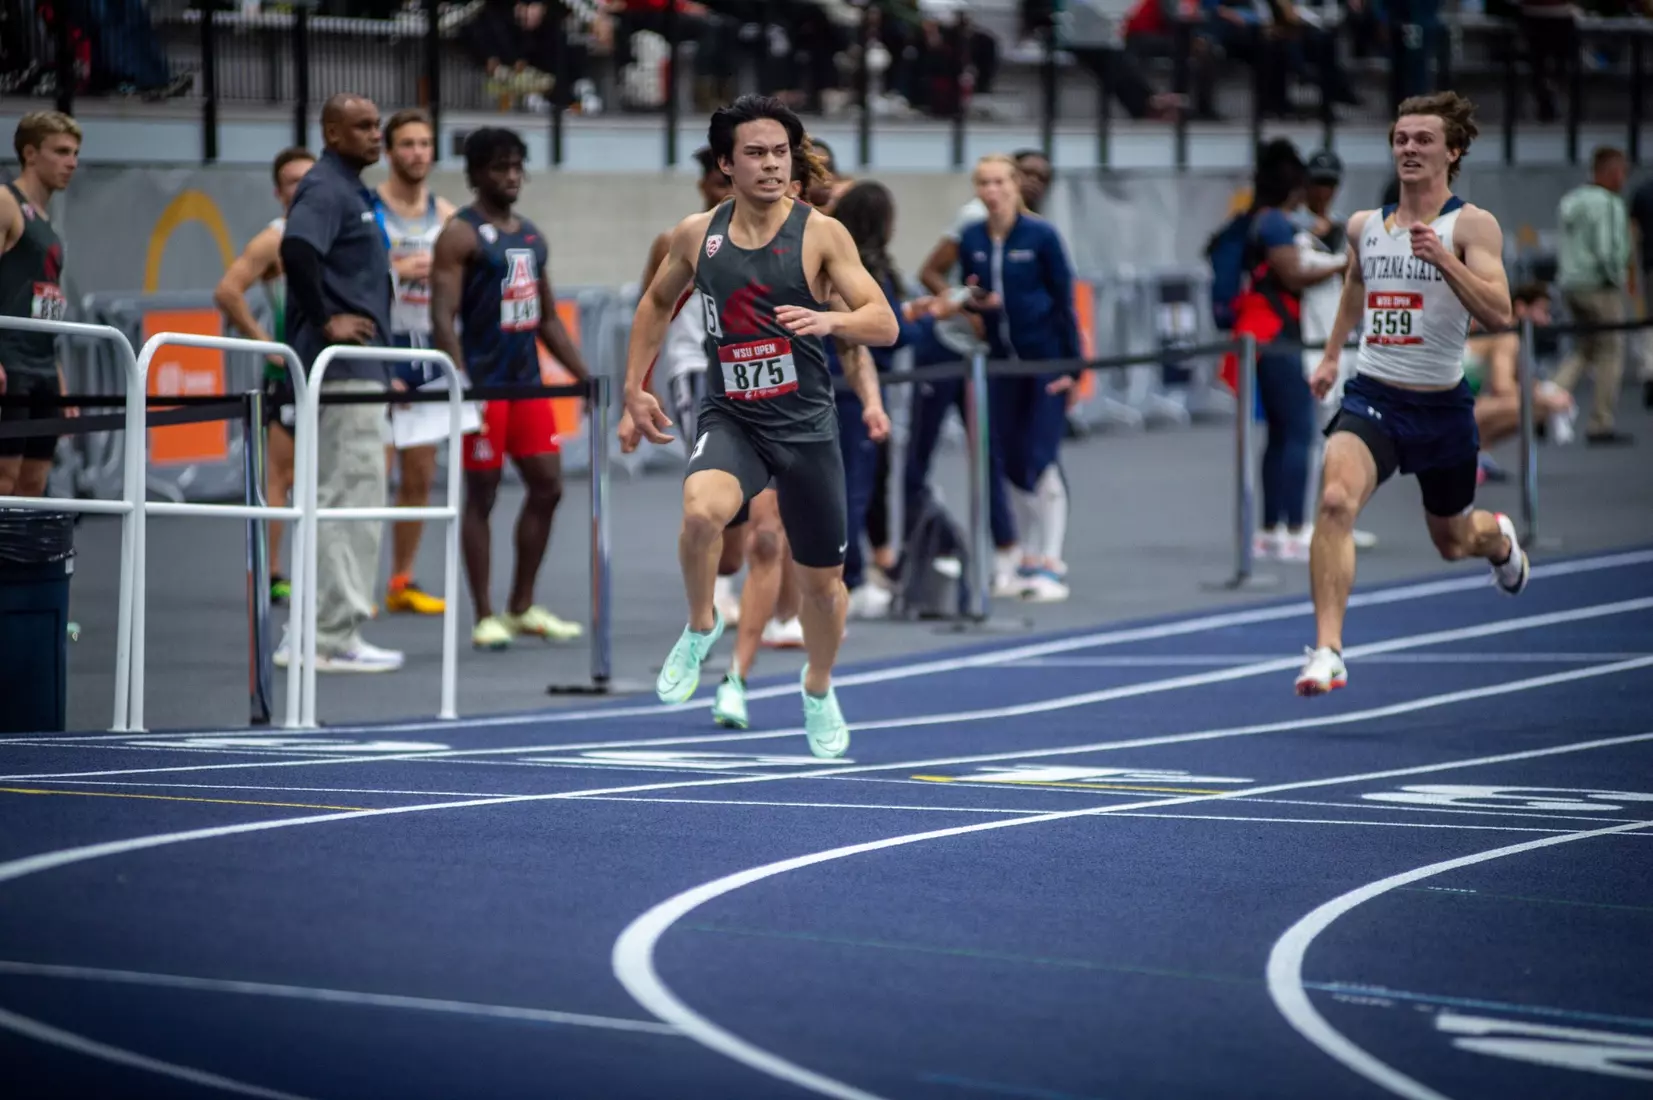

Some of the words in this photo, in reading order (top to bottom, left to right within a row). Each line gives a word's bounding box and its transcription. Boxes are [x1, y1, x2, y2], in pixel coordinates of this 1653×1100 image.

[706, 297, 717, 333] 5
[1373, 310, 1412, 335] 559
[732, 346, 753, 359] WSU
[754, 343, 776, 355] OPEN
[733, 358, 784, 390] 875
